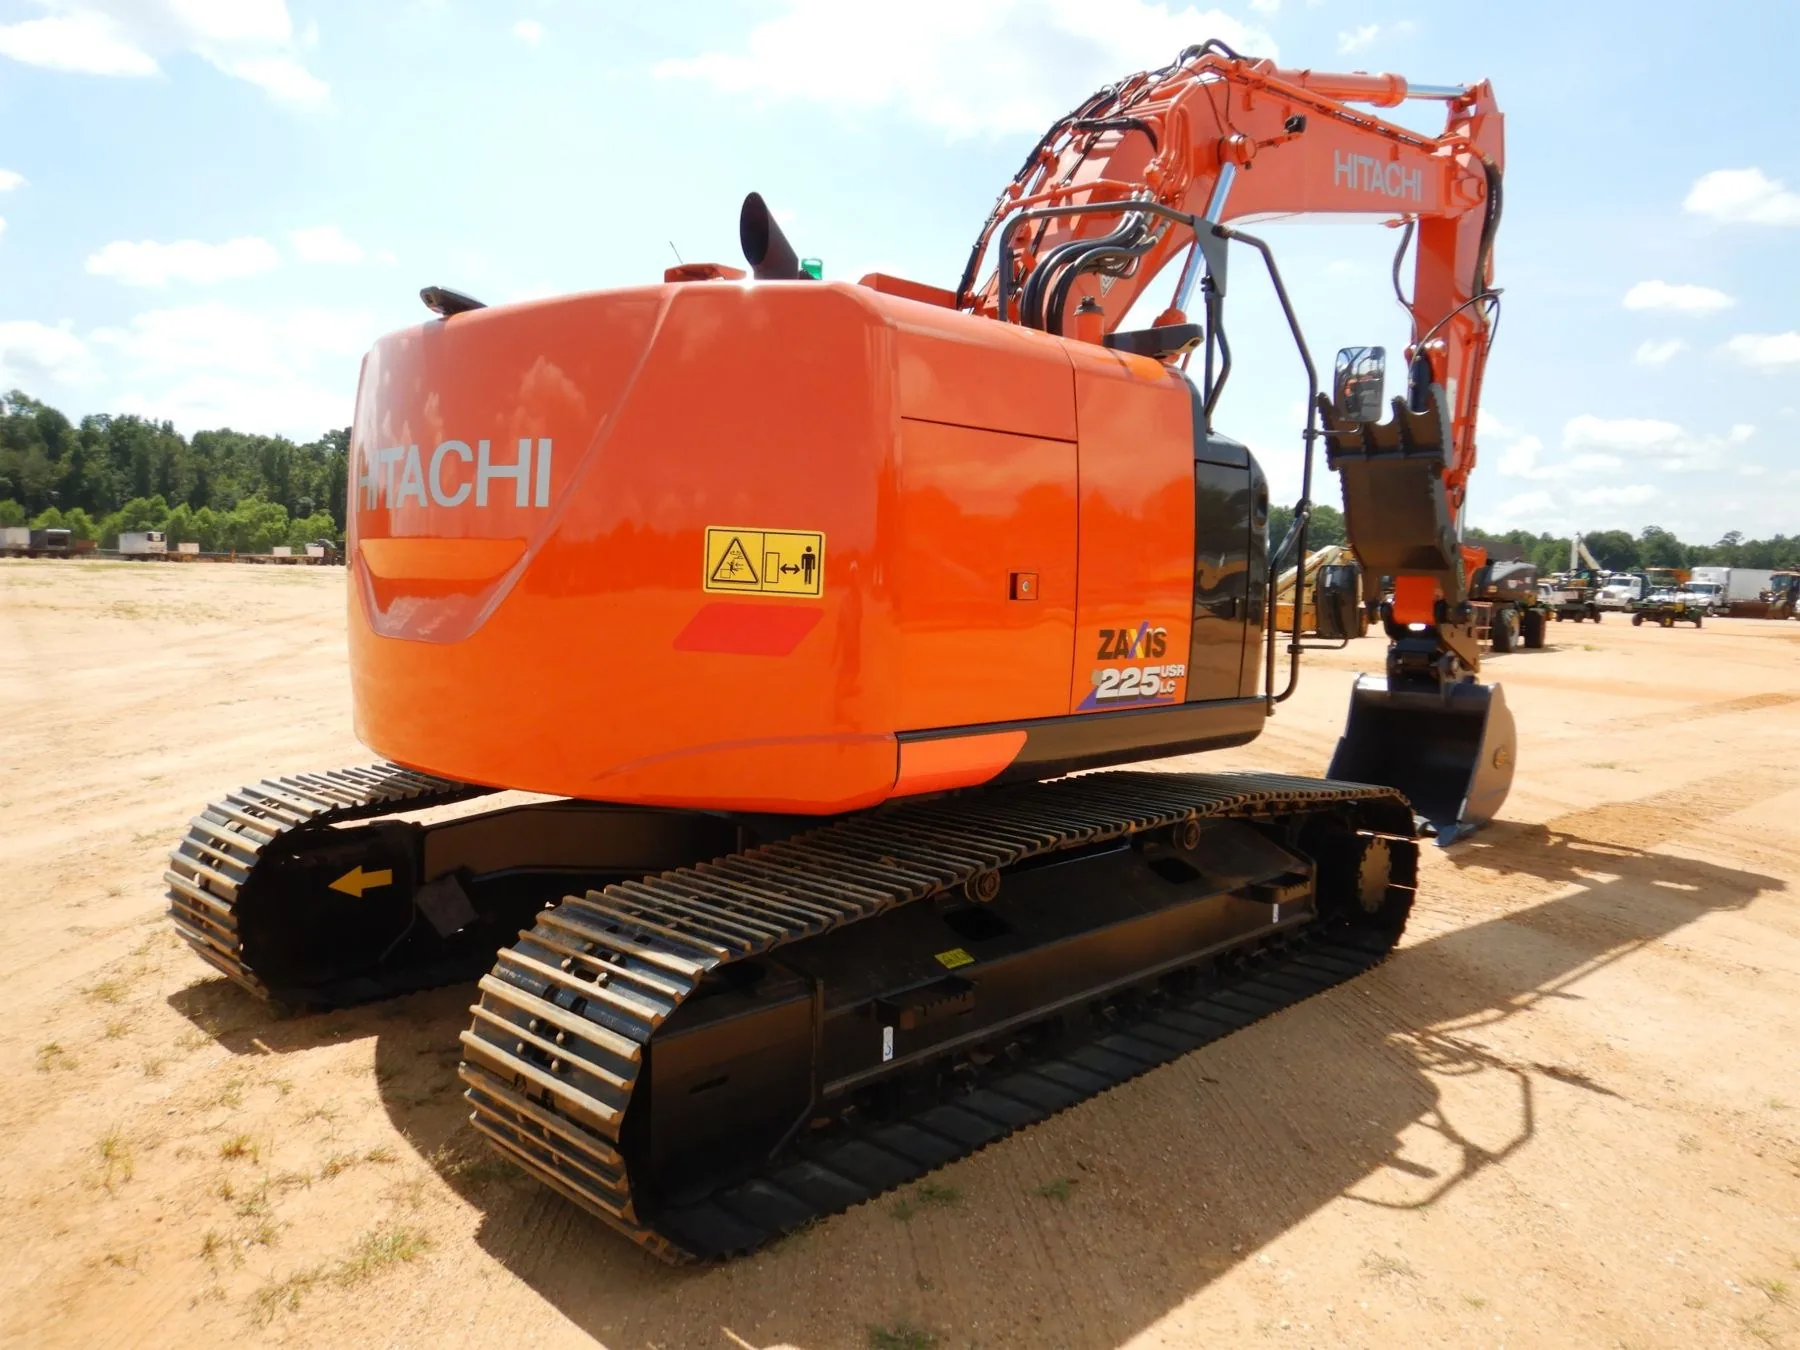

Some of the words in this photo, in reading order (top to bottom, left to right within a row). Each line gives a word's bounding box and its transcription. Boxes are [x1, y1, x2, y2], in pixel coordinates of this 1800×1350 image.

[1333, 149, 1422, 202] HITACHI
[355, 438, 552, 513] HITACHI
[1097, 620, 1168, 660] ZAXIS
[1096, 666, 1161, 701] 225
[1160, 680, 1177, 695] LC
